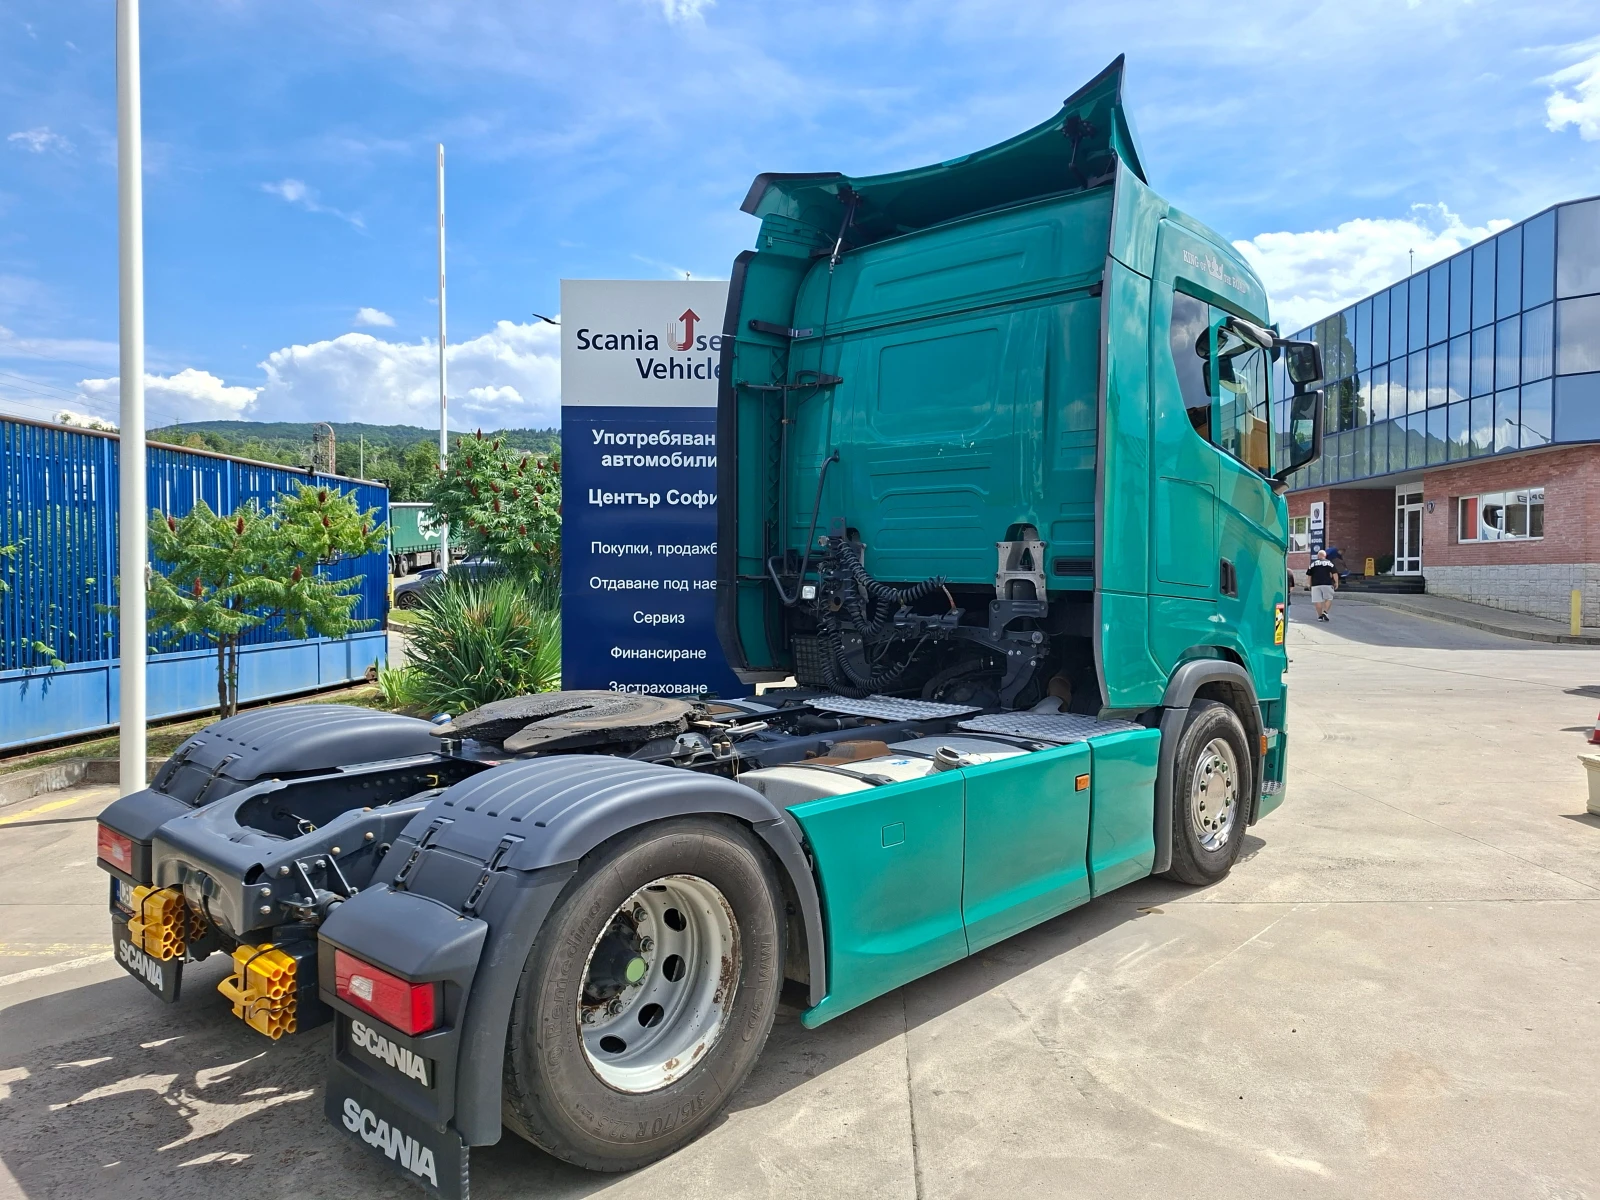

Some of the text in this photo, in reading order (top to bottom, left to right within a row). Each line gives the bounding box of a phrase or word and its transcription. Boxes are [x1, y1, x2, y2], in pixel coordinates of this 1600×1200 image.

[576, 328, 659, 351] Scania
[592, 428, 716, 449] Употребяван
[601, 451, 717, 468] автомобили
[588, 488, 661, 509] Център
[591, 541, 653, 557] Покупки,
[589, 576, 659, 591] Отдаване
[663, 579, 689, 591] под
[633, 611, 685, 626] Сервиз
[610, 646, 707, 662] Финансиране
[608, 681, 708, 695] Застраховане
[119, 939, 164, 992] SCANIA
[351, 1020, 429, 1087] SCANIA
[651, 1090, 705, 1136] 315/70
[341, 1097, 438, 1188] SCANIA
